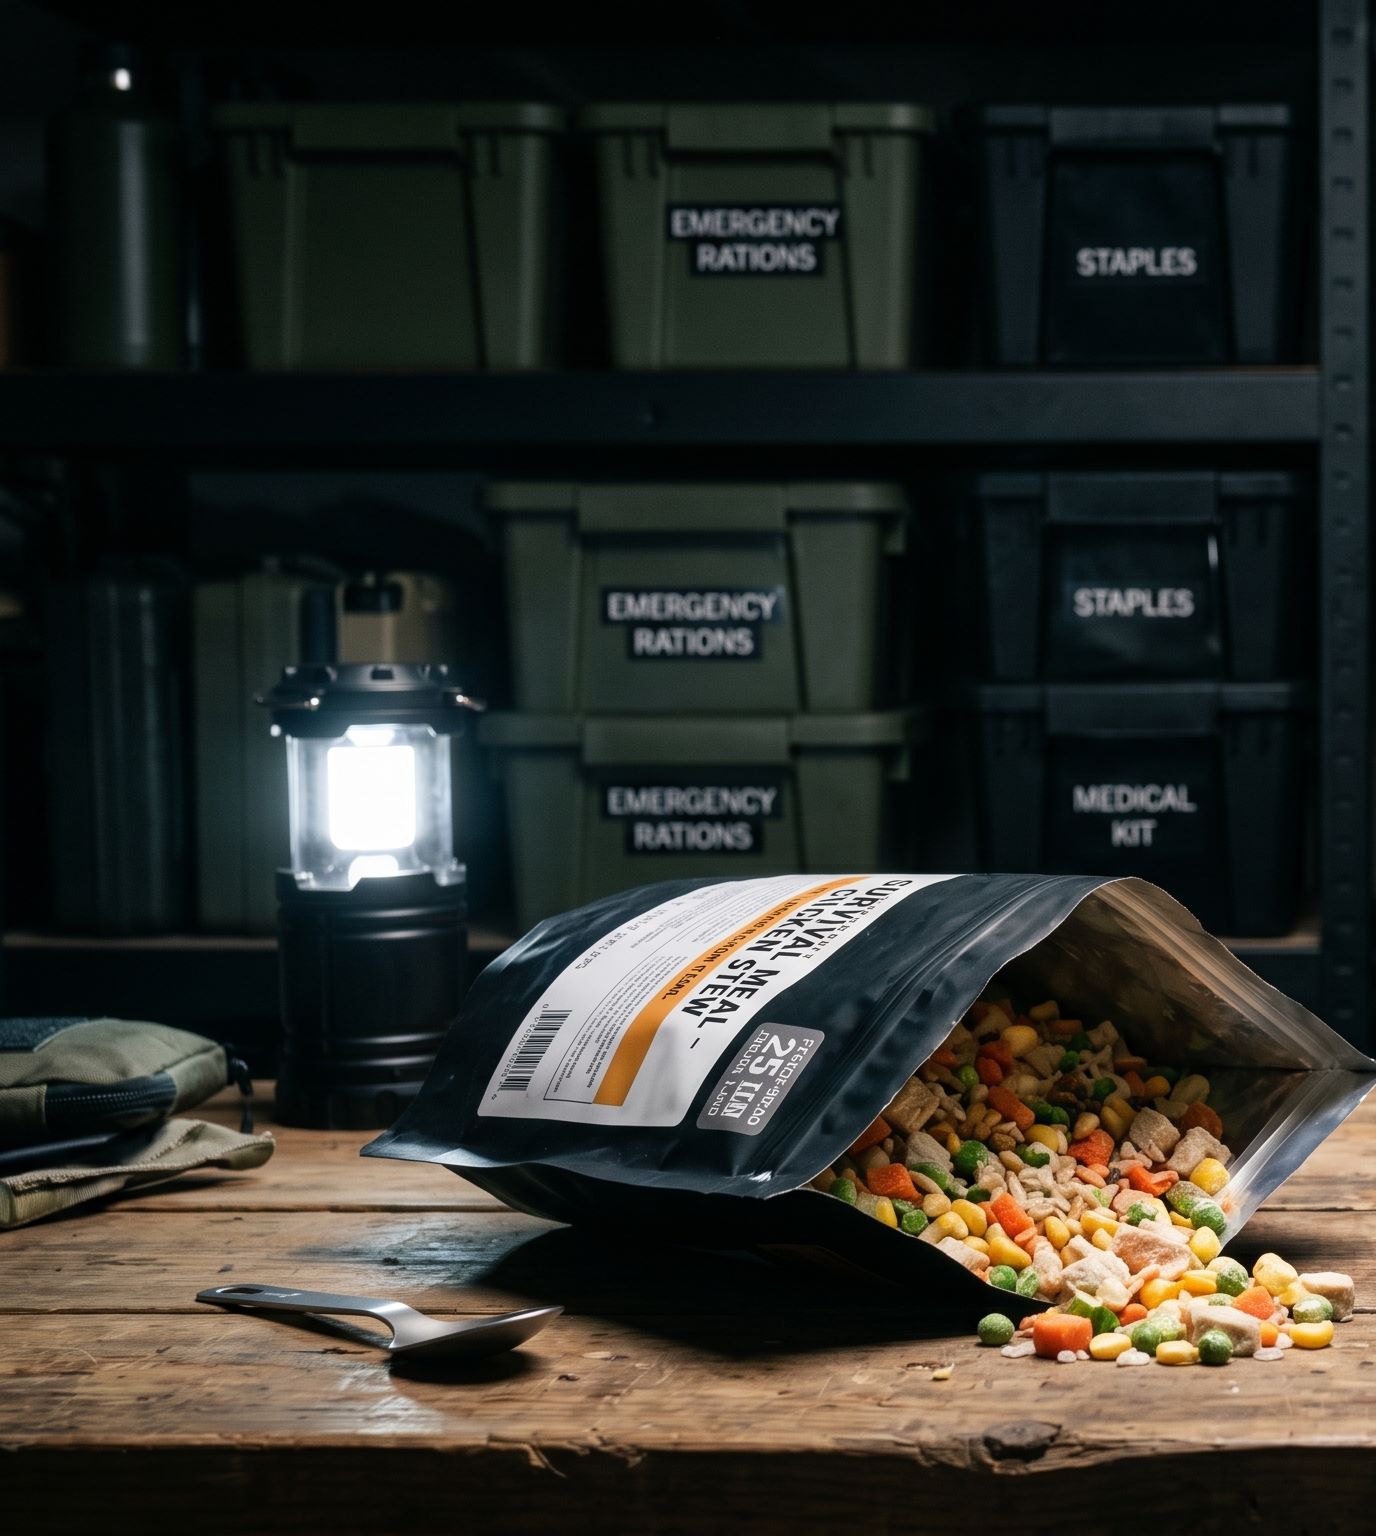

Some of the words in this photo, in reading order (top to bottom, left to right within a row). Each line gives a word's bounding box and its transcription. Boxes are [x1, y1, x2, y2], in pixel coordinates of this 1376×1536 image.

[671, 208, 840, 238] EMERGENCY
[697, 243, 817, 273] RATIONS
[1077, 248, 1197, 277] STAPLES
[607, 592, 778, 621] EMERGENCY
[1073, 588, 1195, 618] STAPLES
[633, 627, 754, 656] RATIONS
[607, 787, 777, 816] EMERGENCY
[1073, 785, 1197, 813] MEDICAL
[633, 822, 753, 851] RATIONS
[1111, 819, 1157, 847] KIT
[770, 879, 913, 961] SURVIVAL
[681, 958, 757, 1017] STEW
[697, 967, 781, 1029] MEAL
[748, 1034, 797, 1077] 25
